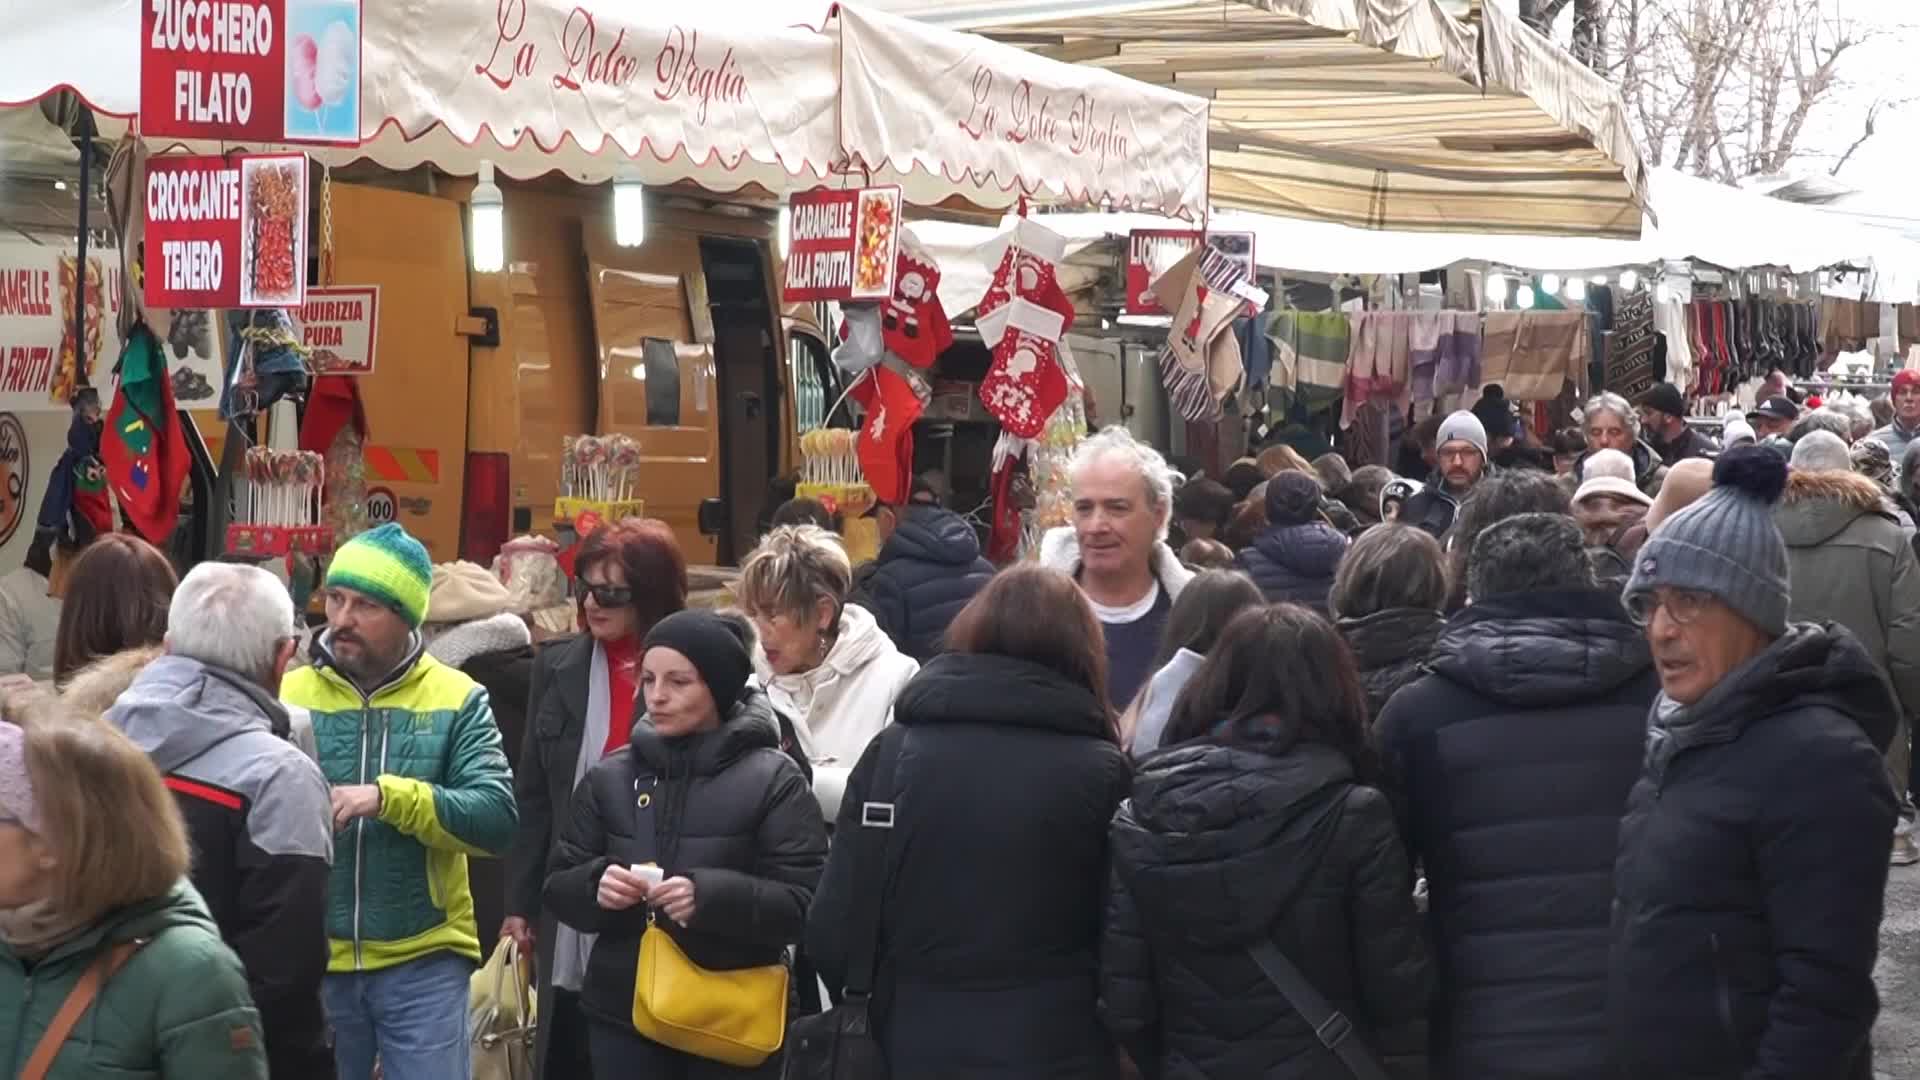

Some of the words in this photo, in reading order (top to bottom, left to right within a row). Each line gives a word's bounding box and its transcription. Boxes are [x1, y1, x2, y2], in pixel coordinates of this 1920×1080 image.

[151, 0, 273, 56] ZUCCHERO
[475, 0, 538, 89] La
[553, 7, 637, 91] Dolce
[654, 24, 745, 126] Voglia
[175, 70, 252, 125] FILATO
[958, 65, 997, 141] La
[1005, 78, 1057, 144] Dolce
[1069, 93, 1128, 174] Voglia
[147, 170, 240, 222] CROCCANTE
[793, 201, 853, 240] CARAMELLE
[162, 239, 223, 292] TENERO
[785, 252, 811, 289] ALLA
[812, 250, 851, 288] FRUTTA
[0, 269, 52, 316] AMELLE
[297, 300, 363, 324] QUIRIZIA
[303, 326, 343, 346] PURA
[1, 347, 53, 392] FRUTTA
[368, 500, 391, 519] 100
